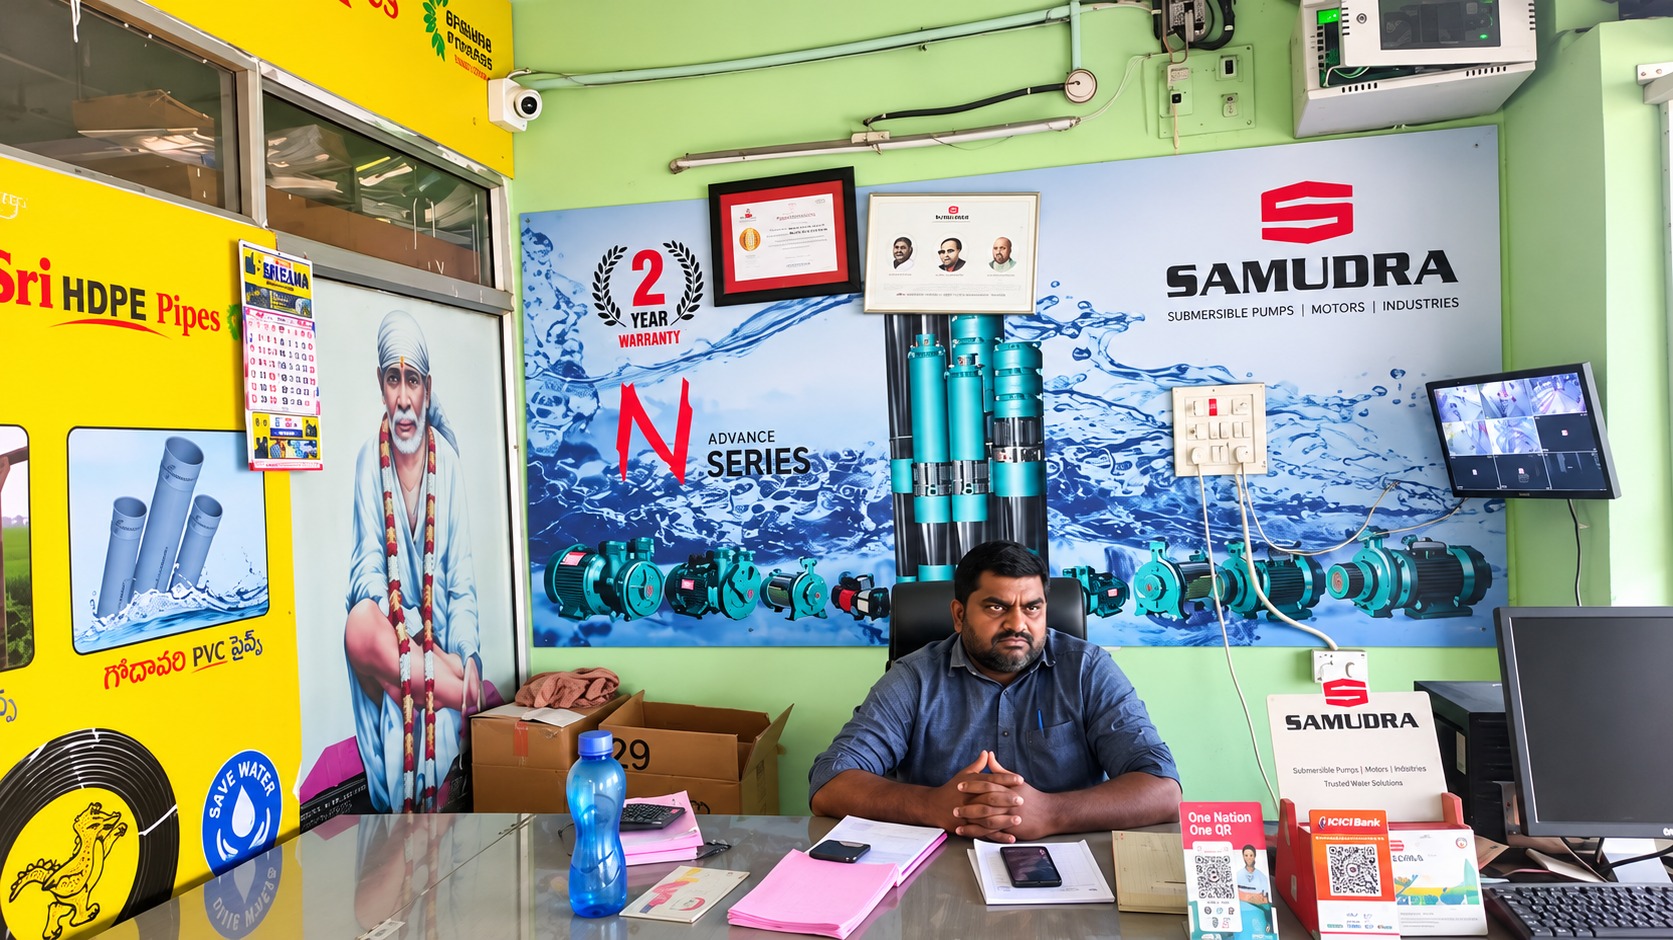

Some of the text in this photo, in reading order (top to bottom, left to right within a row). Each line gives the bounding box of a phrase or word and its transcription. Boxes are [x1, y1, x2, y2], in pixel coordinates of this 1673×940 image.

[632, 249, 665, 307] 2
[1166, 250, 1458, 297] SAMUDRA
[62, 275, 147, 321] HDPE
[156, 292, 221, 336] Pipes
[1167, 297, 1459, 321] SUBMERSIBLE PUMPS MOTORS INDUSTRIES
[631, 310, 668, 329] YEAR
[618, 330, 681, 348] WARRANTY
[615, 376, 693, 486] N
[708, 430, 776, 445] ADVANCE
[707, 446, 811, 478] SERIES
[193, 641, 225, 667] PVC
[1285, 712, 1419, 731] SAMUDRA
[209, 760, 276, 819] SAVE WATER
[1188, 811, 1252, 823] One Nation
[1327, 817, 1381, 827] ICICI Bank
[1189, 824, 1232, 837] One QR
